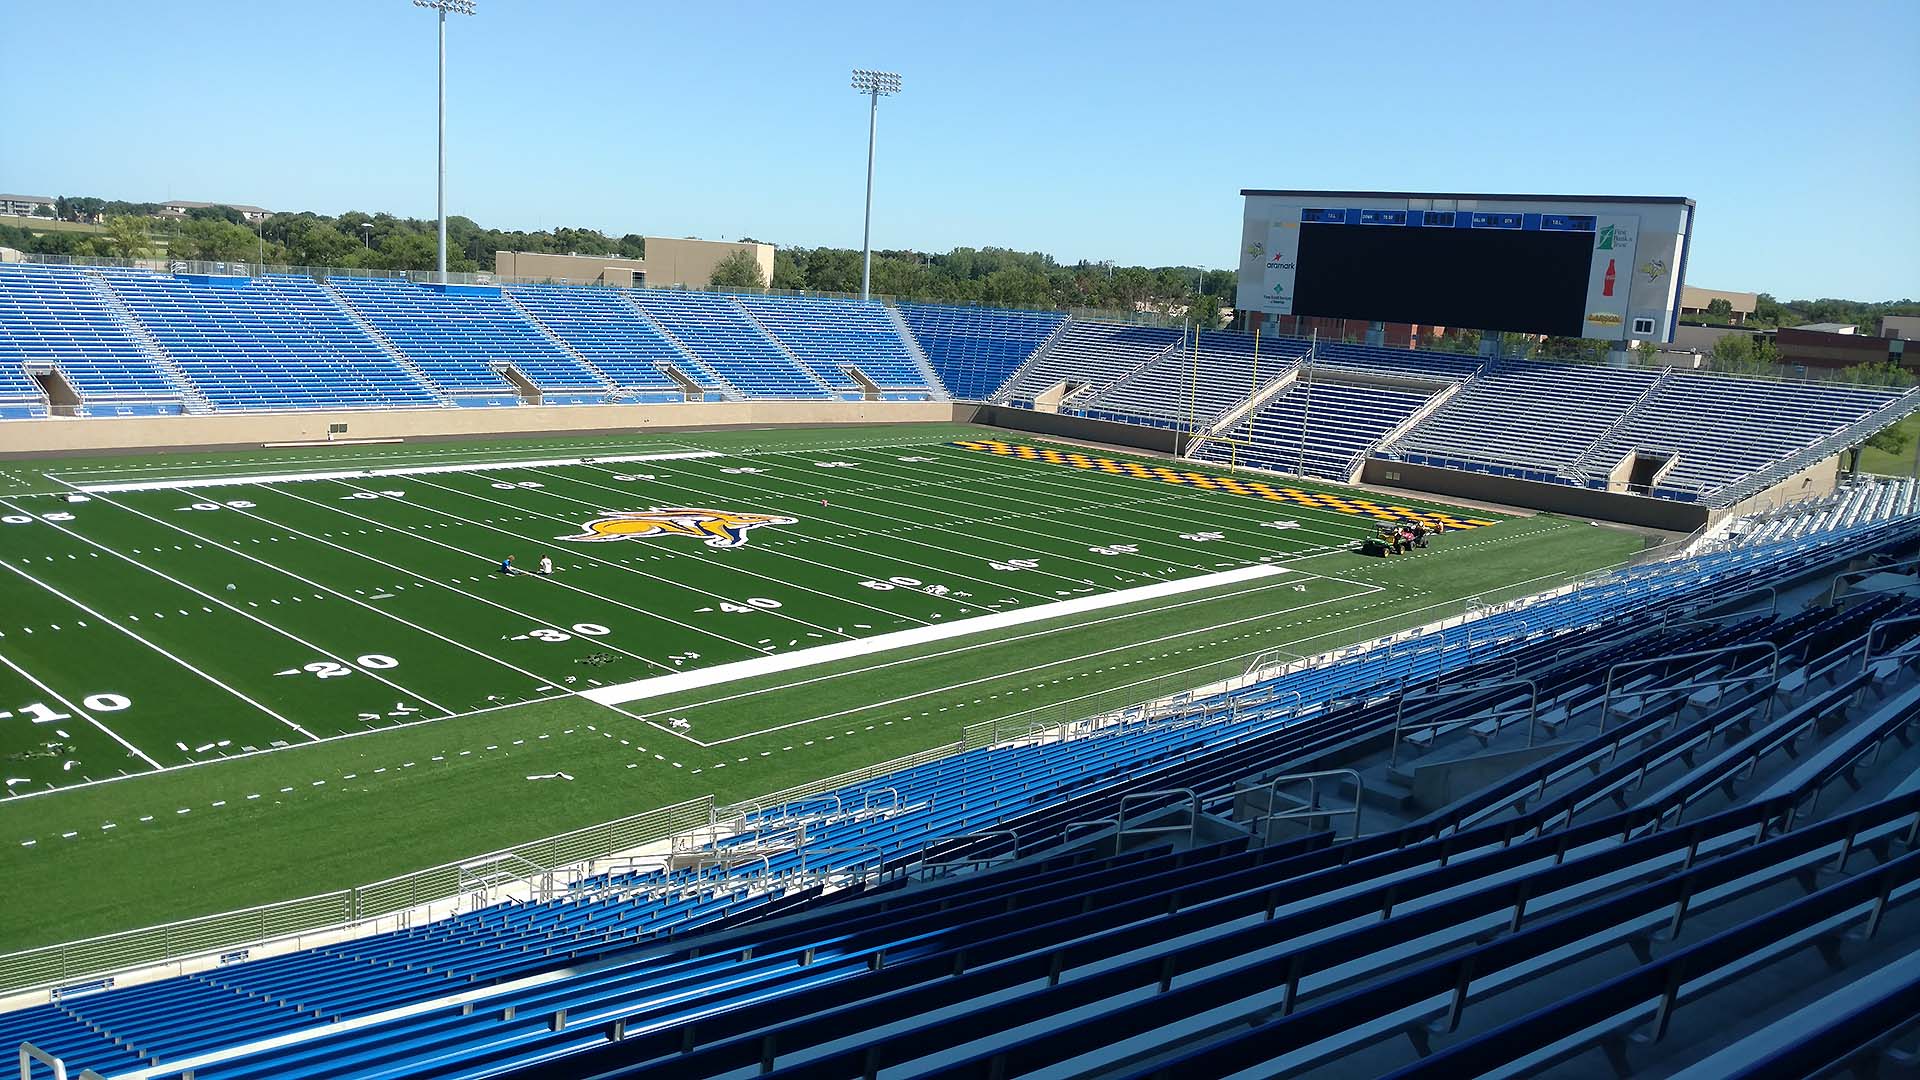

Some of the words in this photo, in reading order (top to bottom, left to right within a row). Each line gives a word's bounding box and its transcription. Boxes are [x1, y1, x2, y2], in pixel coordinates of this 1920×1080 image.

[1266, 260, 1295, 270] aramark
[352, 490, 405, 500] 40
[191, 500, 257, 511] 30
[1, 512, 76, 524] 20
[1088, 544, 1139, 556] 30
[988, 558, 1038, 571] 40
[858, 576, 922, 591] 50
[720, 597, 782, 613] 40
[528, 623, 611, 642] 30
[303, 653, 399, 679] 20
[18, 693, 132, 723] 10
